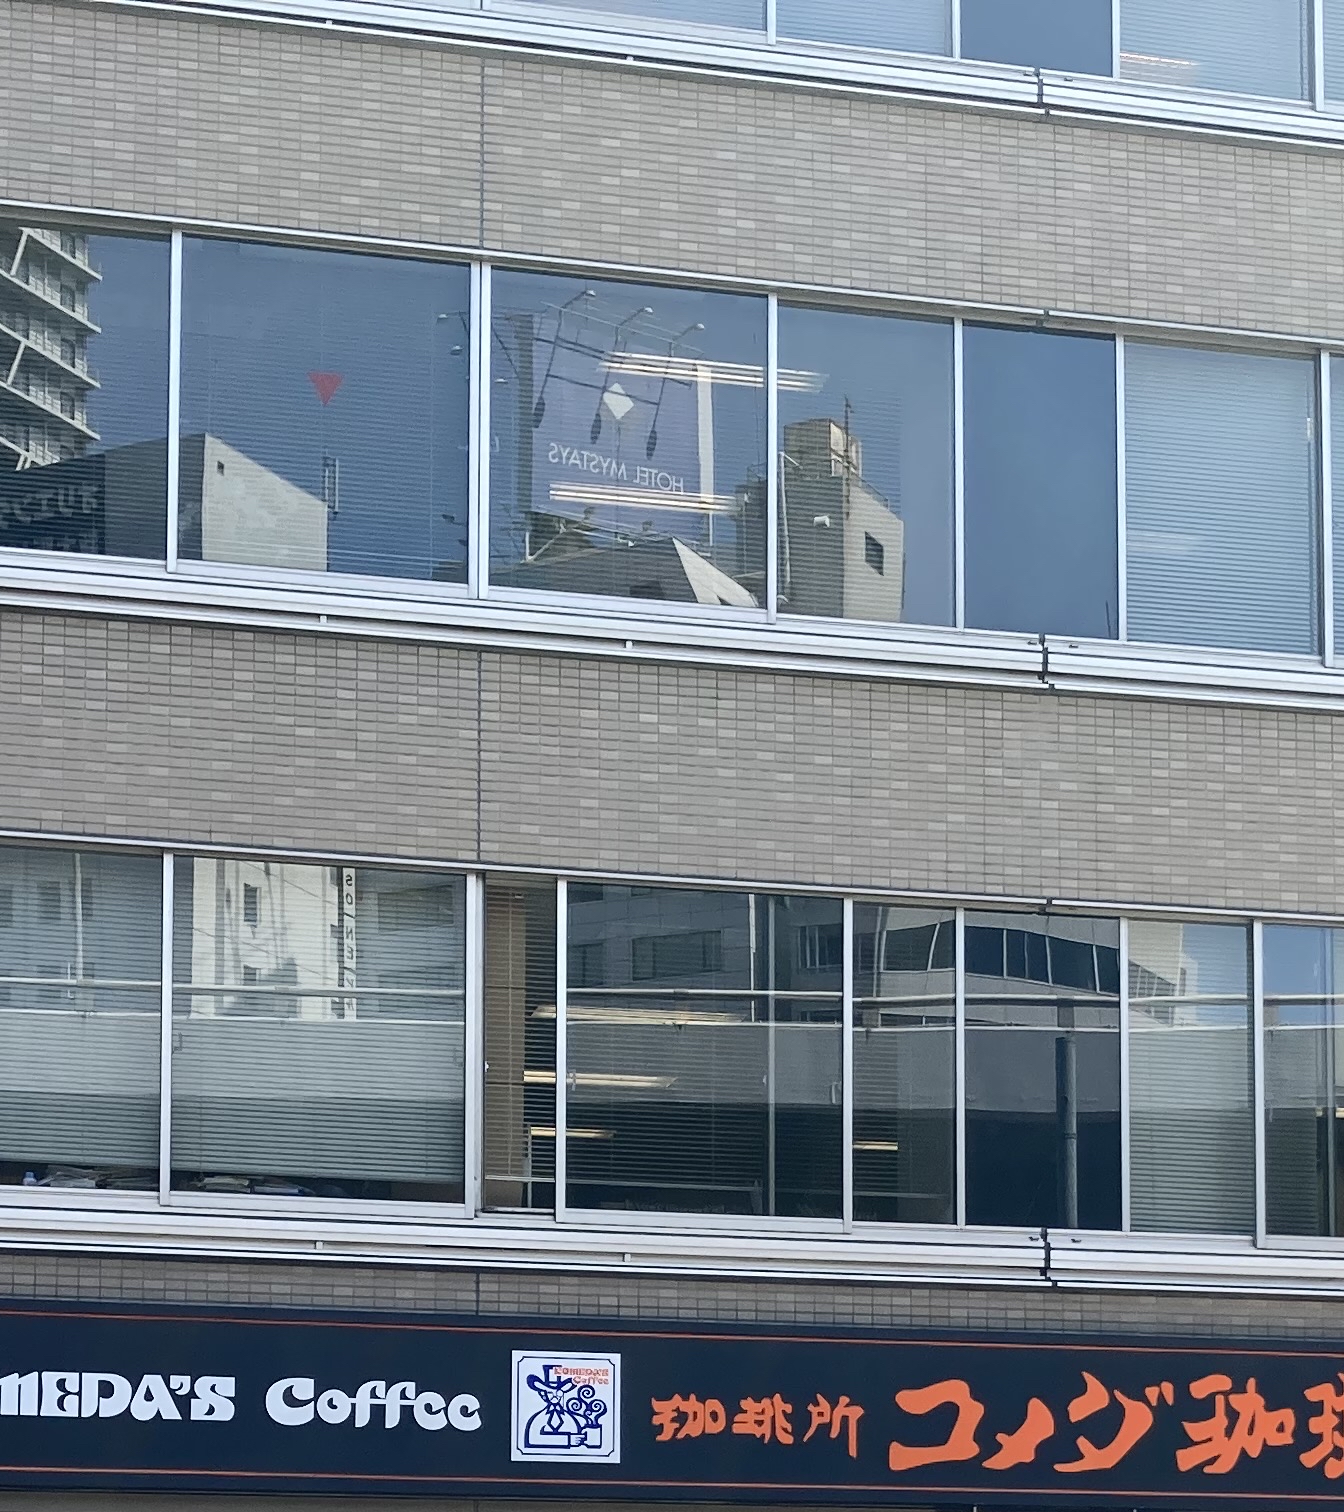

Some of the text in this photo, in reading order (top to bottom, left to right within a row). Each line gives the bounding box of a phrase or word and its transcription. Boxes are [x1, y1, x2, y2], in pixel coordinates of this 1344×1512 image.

[265, 1376, 482, 1432] Coffee
[651, 1393, 865, 1458] 珈琲所
